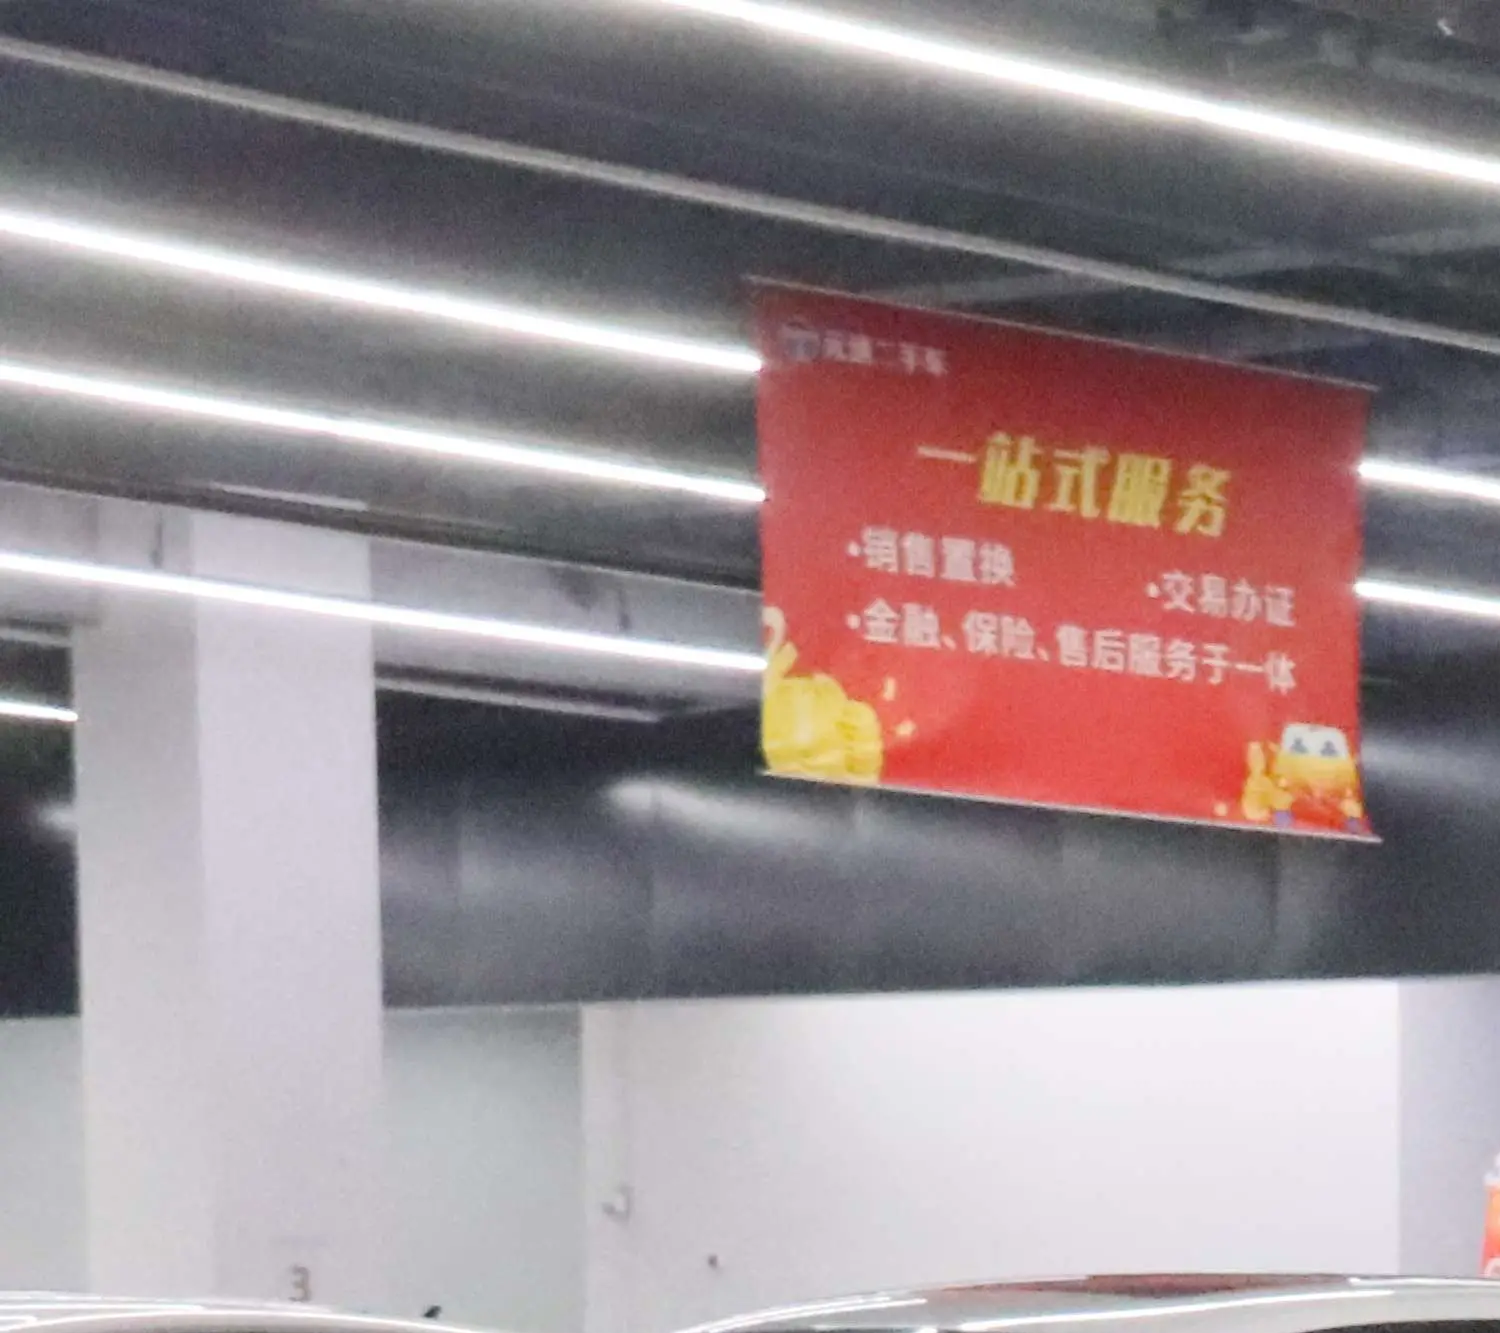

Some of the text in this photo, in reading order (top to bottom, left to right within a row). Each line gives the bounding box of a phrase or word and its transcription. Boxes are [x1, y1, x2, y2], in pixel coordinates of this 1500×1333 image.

[916, 431, 1231, 537] 一站式服务
